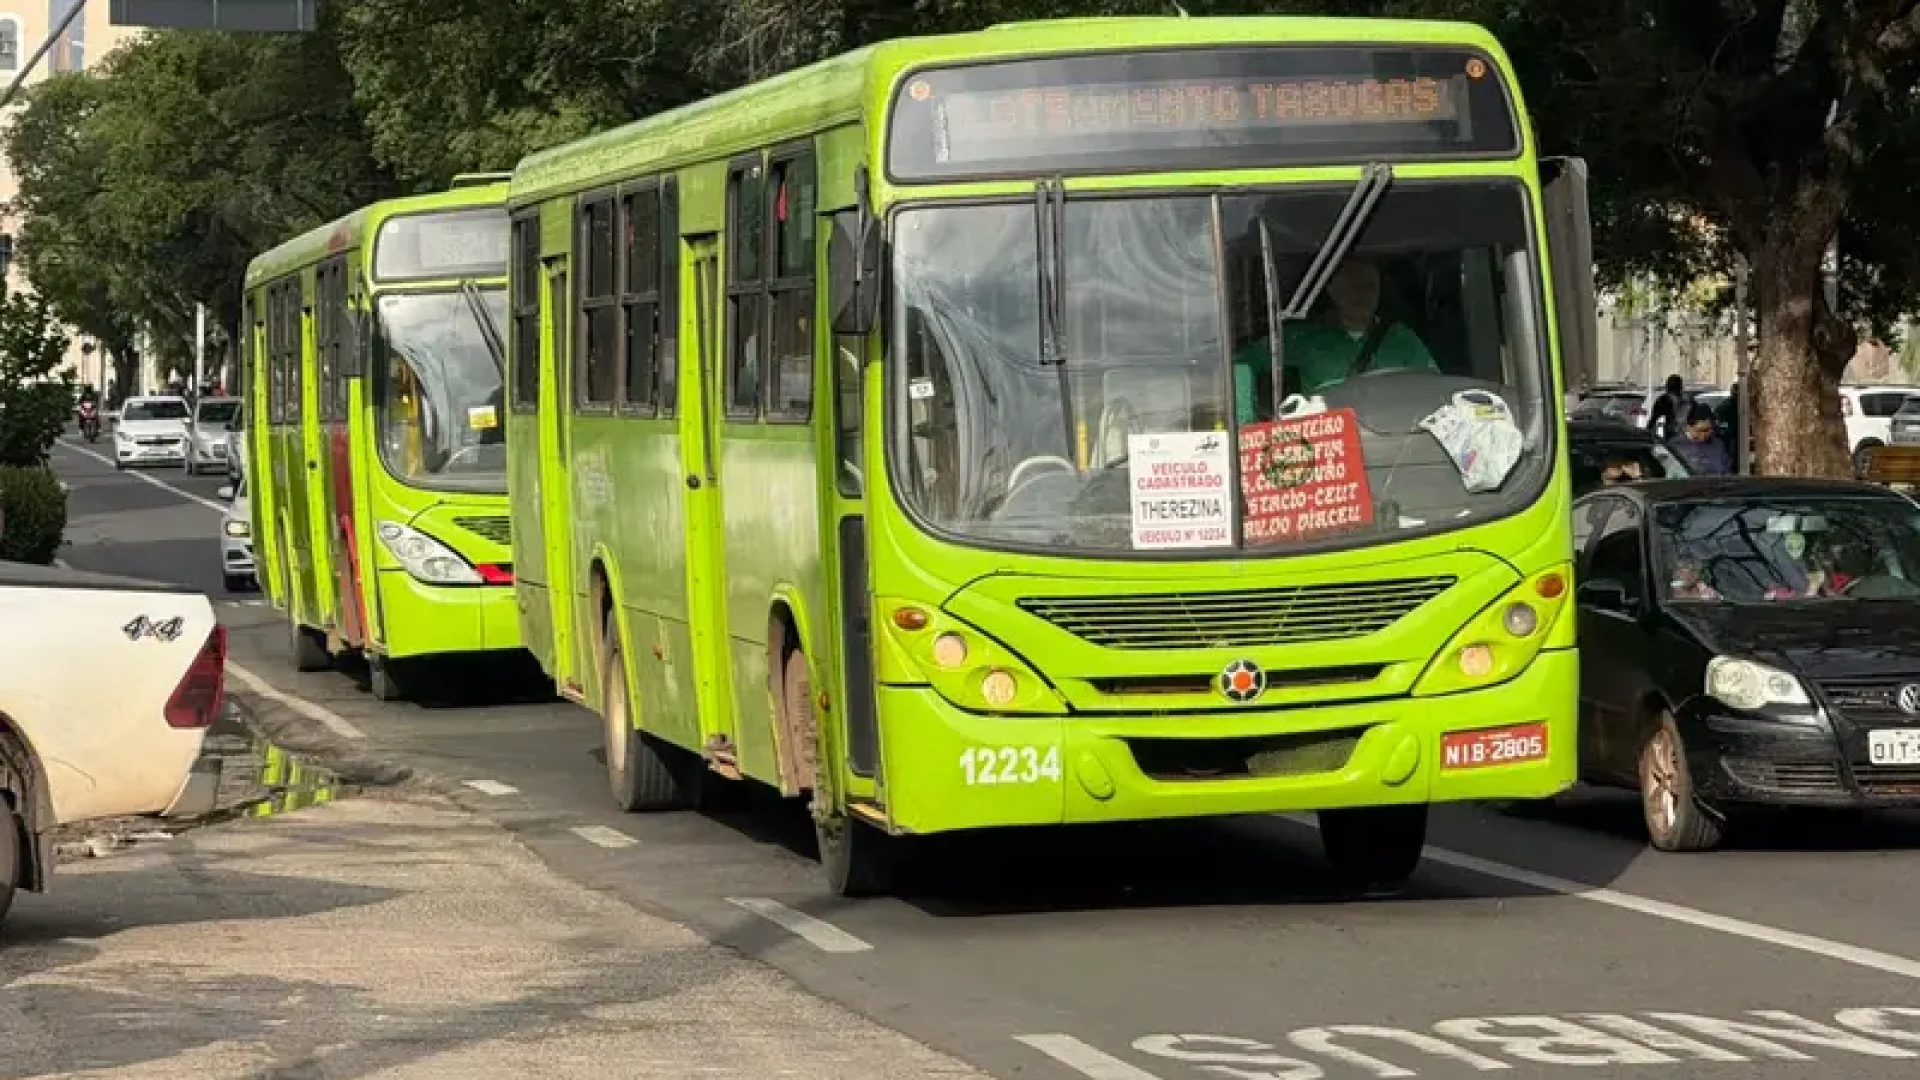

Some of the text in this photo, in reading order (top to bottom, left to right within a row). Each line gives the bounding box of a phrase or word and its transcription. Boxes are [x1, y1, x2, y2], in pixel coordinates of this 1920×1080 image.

[1137, 475, 1223, 491] CADASTRADO
[1140, 498, 1222, 521] THEREZINA
[1445, 736, 1542, 765] NIB-2805
[959, 745, 1061, 786] 12234
